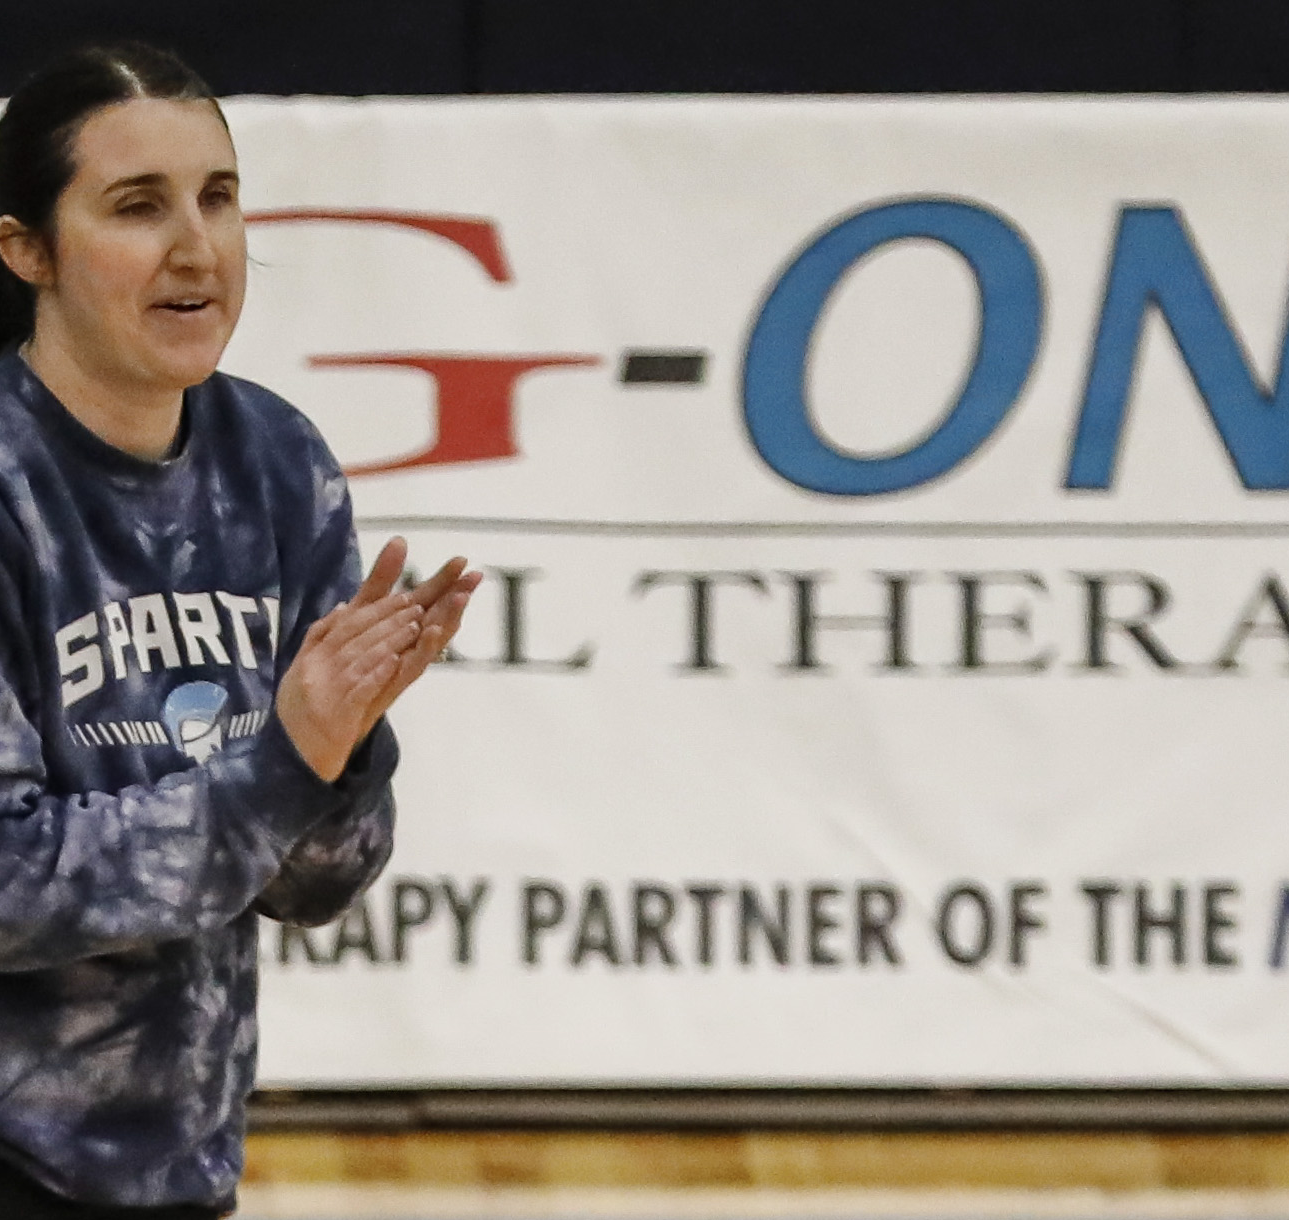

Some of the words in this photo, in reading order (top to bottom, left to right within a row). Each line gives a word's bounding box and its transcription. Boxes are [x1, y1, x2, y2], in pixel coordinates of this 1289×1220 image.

[517, 880, 903, 968] PARTNER
[935, 882, 1046, 968] OF
[1078, 880, 1241, 968] THE
